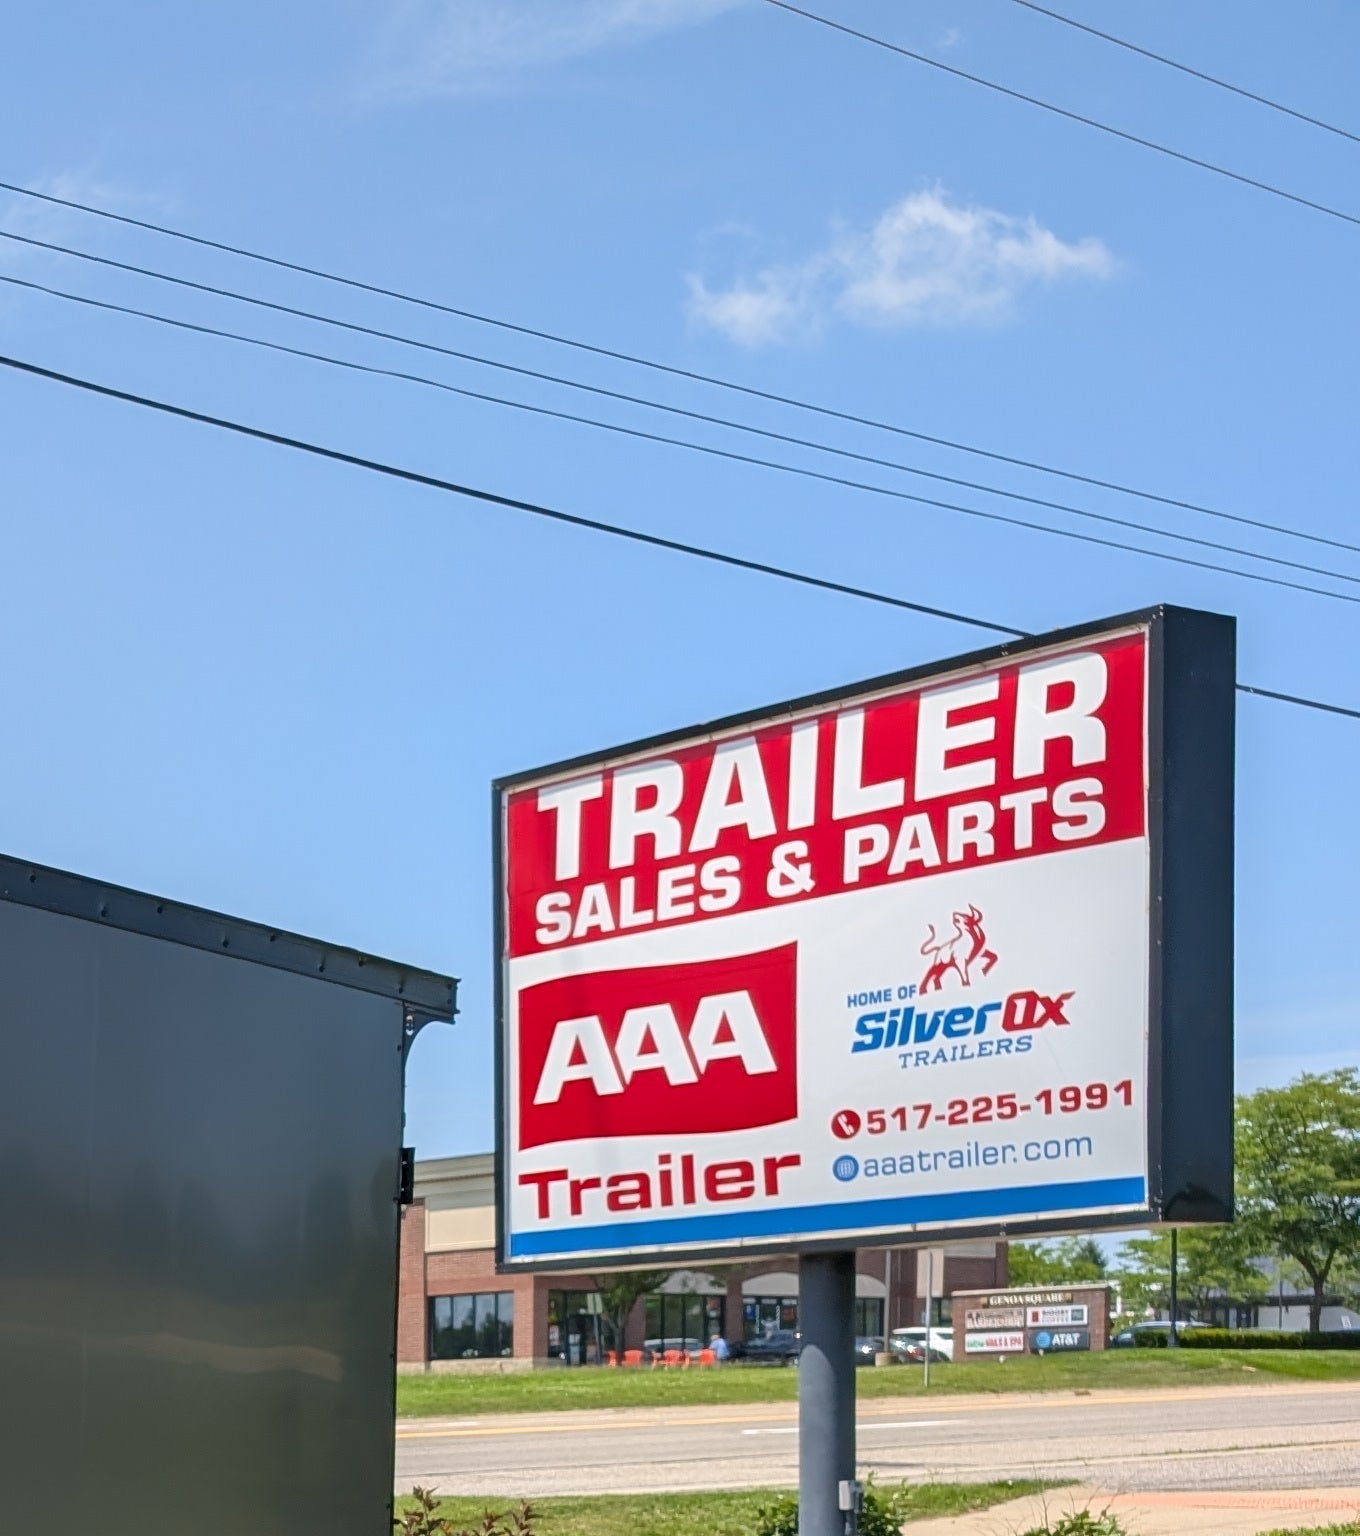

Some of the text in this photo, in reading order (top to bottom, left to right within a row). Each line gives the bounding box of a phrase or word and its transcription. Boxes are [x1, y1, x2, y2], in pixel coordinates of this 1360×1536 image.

[536, 651, 1108, 881] TRAILER
[534, 776, 1107, 946] SALES & PARTS
[847, 984, 917, 1008] HOME OF
[532, 990, 778, 1107] AAA
[899, 1035, 1033, 1069] TRAILERS
[867, 1079, 1132, 1135] 517-225-1991
[863, 1136, 1093, 1177] aaatrailer.com
[519, 1152, 801, 1220] Trailer
[990, 1292, 1065, 1307] GENOA SQUARE
[1052, 1333, 1080, 1347] AT&T
